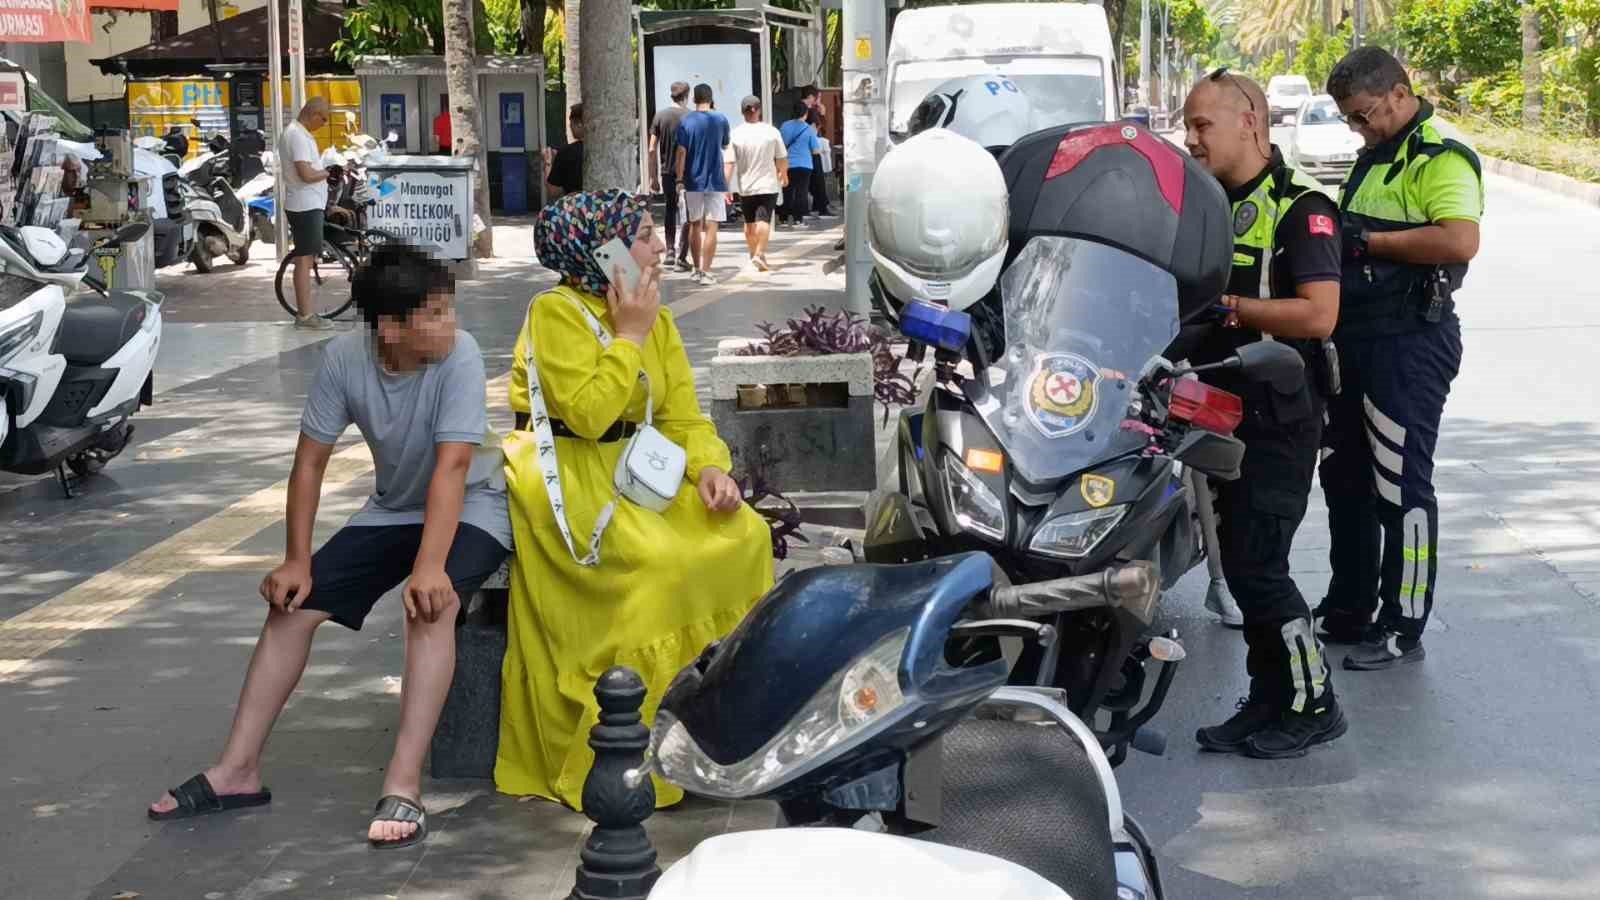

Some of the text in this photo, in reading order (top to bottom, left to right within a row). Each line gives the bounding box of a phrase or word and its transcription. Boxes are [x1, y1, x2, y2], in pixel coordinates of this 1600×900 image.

[400, 182, 453, 198] Manavgat
[371, 200, 454, 219] TÜRK TELEKOM
[373, 222, 451, 242] ÜDÜRLÜĞÜ
